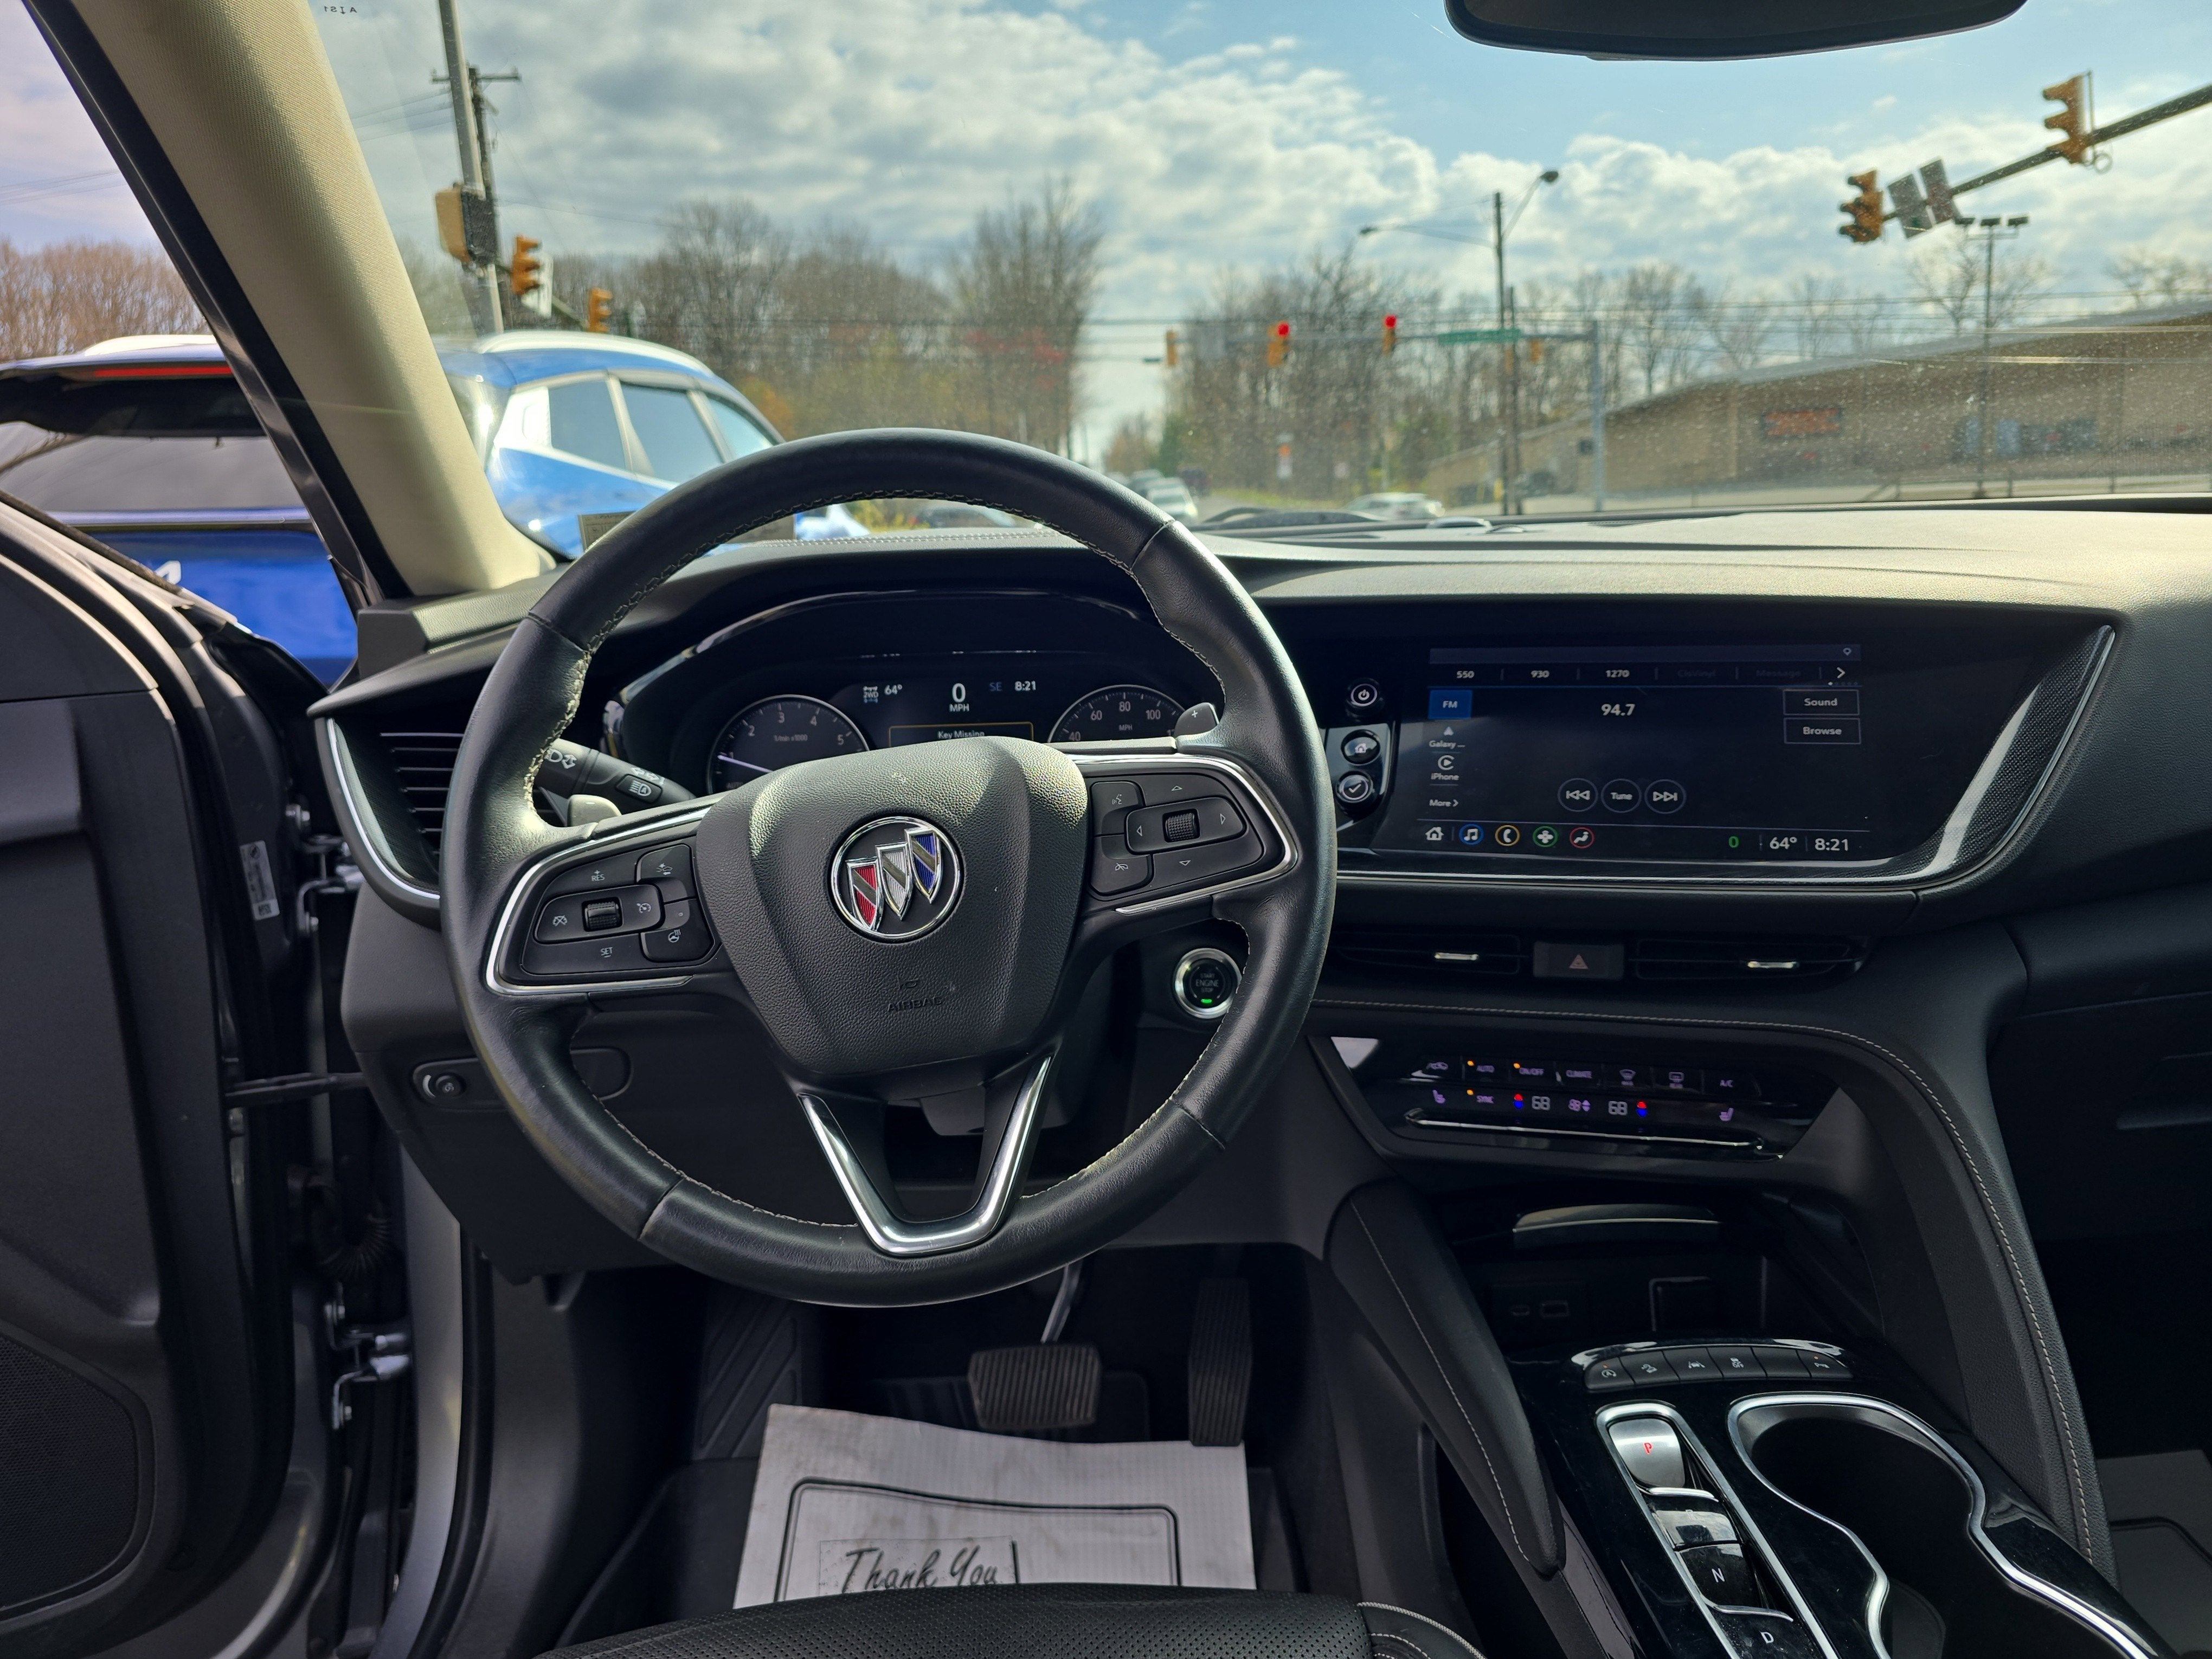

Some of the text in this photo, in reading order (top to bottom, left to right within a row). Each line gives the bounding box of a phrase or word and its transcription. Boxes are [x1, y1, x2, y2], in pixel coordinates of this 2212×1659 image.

[1456, 671, 1475, 679] 550
[1531, 670, 1550, 678] 930
[1605, 669, 1630, 678] 1270
[884, 684, 903, 696] 64°
[989, 681, 1002, 691] SE
[1014, 680, 1037, 691] 8:21
[951, 683, 966, 703] 0
[1119, 701, 1131, 712] 80
[1804, 698, 1838, 706] Sound
[949, 704, 969, 712] MPH
[1601, 703, 1636, 716] 94.7
[777, 712, 785, 723] 3
[1090, 710, 1103, 721] 60
[1146, 709, 1161, 720] 100
[810, 716, 817, 726] 4
[748, 725, 755, 737] 2
[938, 731, 953, 740] Key
[1803, 726, 1842, 735] Browse
[838, 734, 845, 745] 5
[1069, 731, 1081, 742] 40
[1429, 740, 1456, 749] Galaxy
[1430, 773, 1459, 781] iPhone
[1610, 792, 1633, 800] Tune
[1429, 799, 1451, 807] More
[1769, 837, 1798, 850] 64°
[1814, 838, 1849, 851] 8:21
[600, 947, 613, 956] SET
[1531, 1096, 1551, 1110] 68
[1608, 1101, 1628, 1116] 68
[1643, 1442, 1652, 1455] P
[841, 1545, 997, 1593] Thank You
[1711, 1567, 1725, 1583] N
[1761, 1631, 1774, 1644] D
